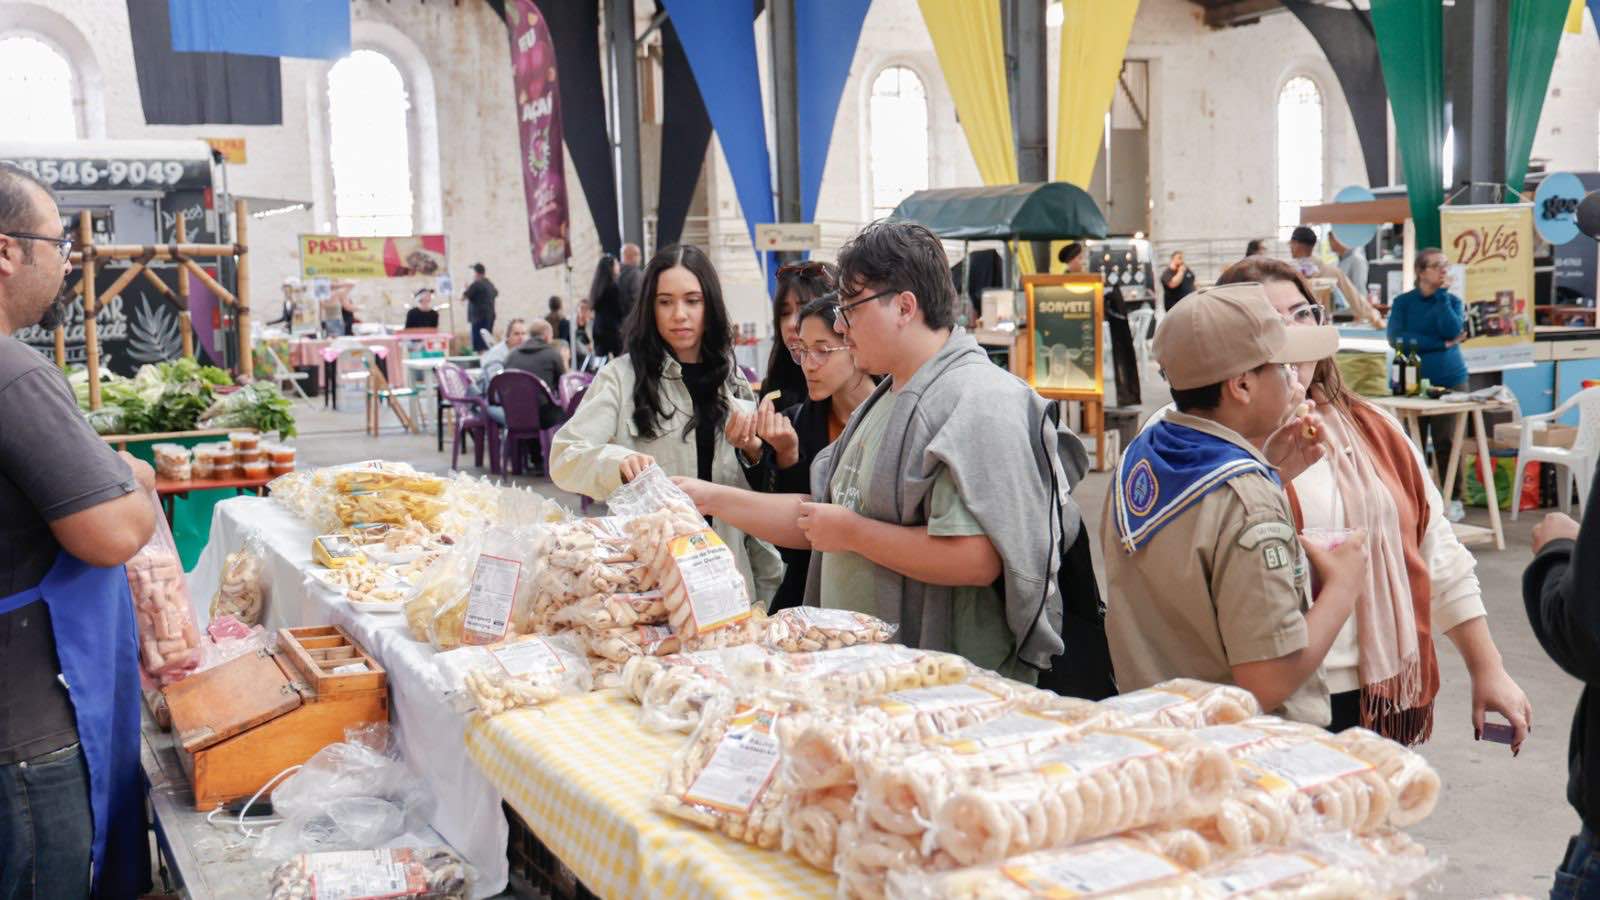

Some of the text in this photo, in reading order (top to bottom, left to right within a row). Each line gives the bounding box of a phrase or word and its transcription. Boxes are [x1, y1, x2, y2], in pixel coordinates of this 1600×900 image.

[0, 157, 184, 186] 8546-9049
[308, 238, 368, 254] PASTEL
[1039, 301, 1091, 313] SORVETE
